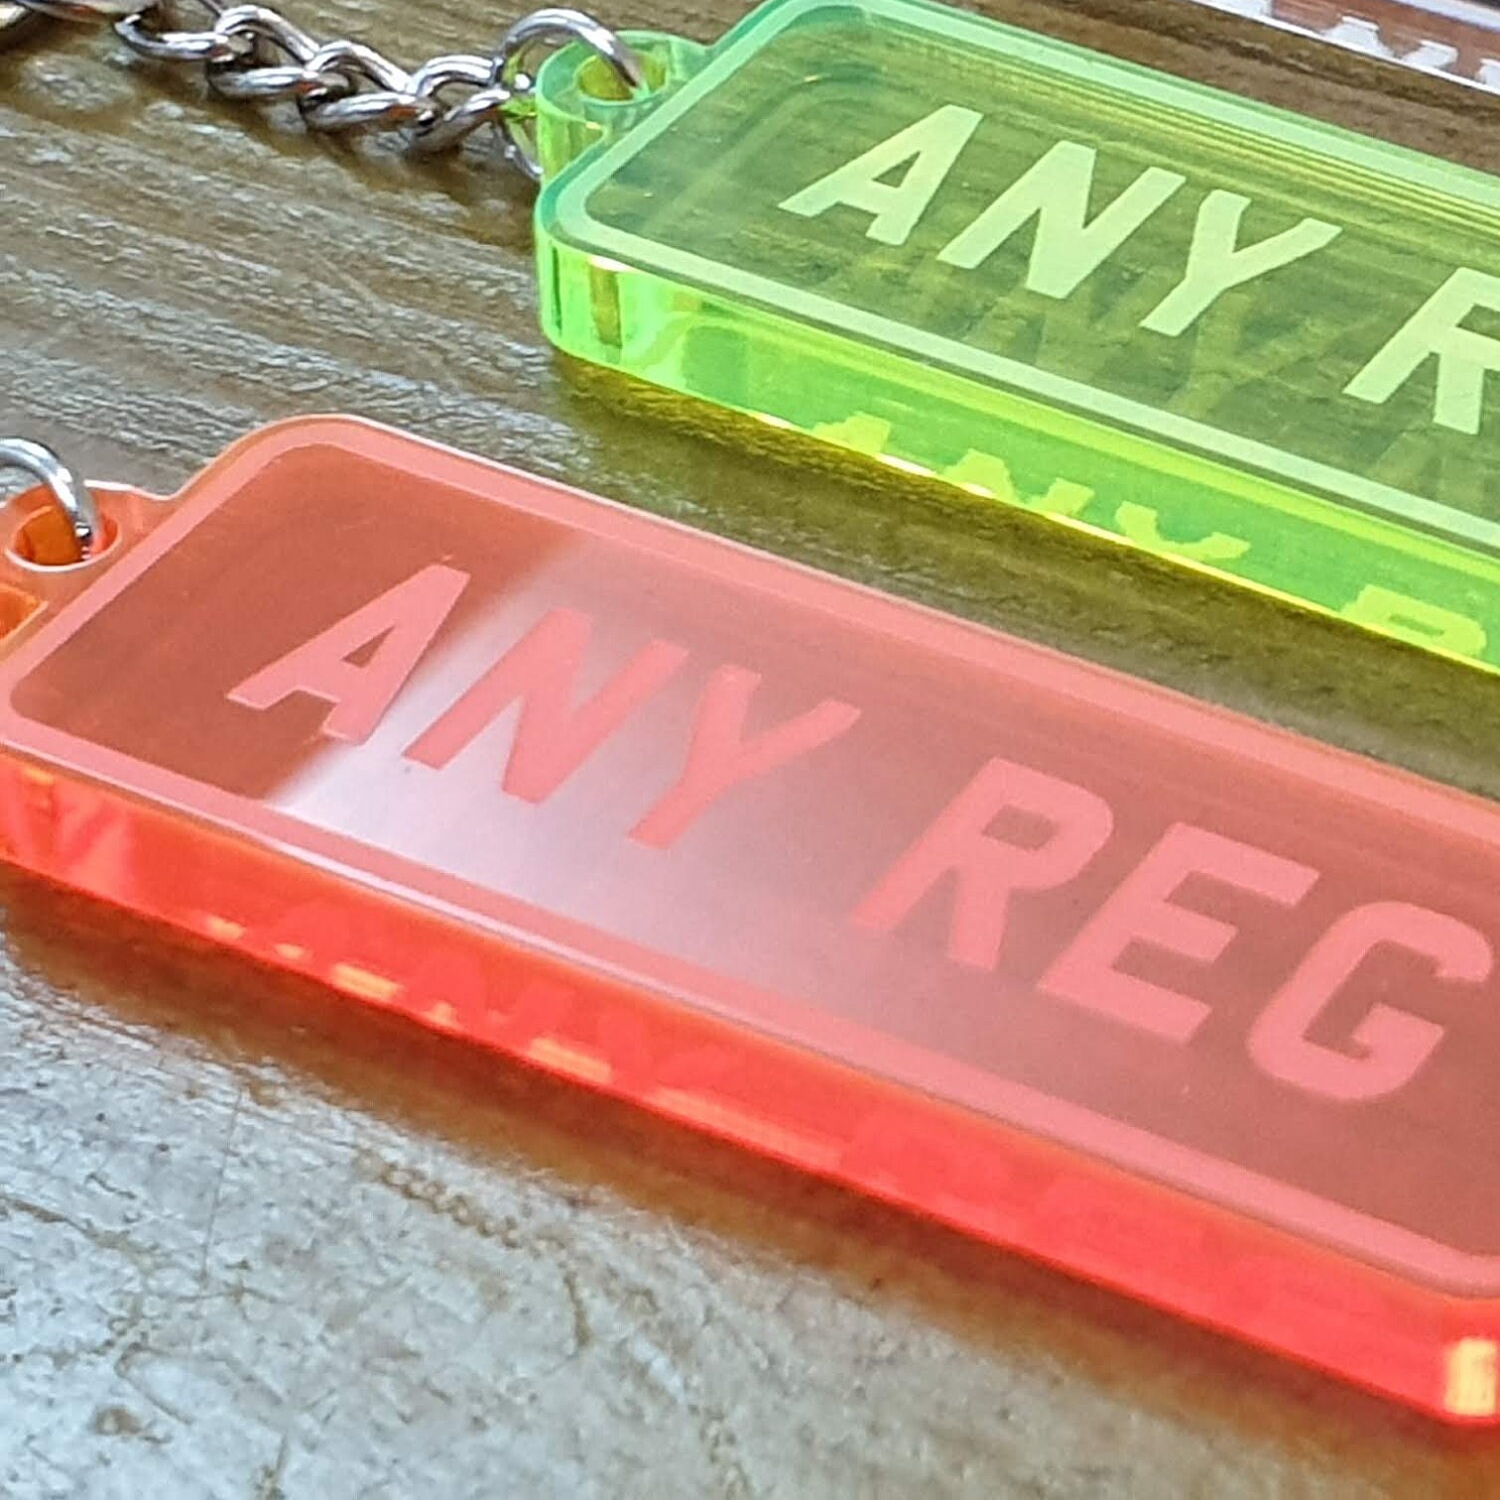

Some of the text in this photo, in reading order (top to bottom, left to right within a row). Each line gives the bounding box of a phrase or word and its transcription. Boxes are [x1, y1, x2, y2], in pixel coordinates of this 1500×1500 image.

[778, 102, 1342, 340] ANY
[224, 562, 1493, 1104] ANY REG
